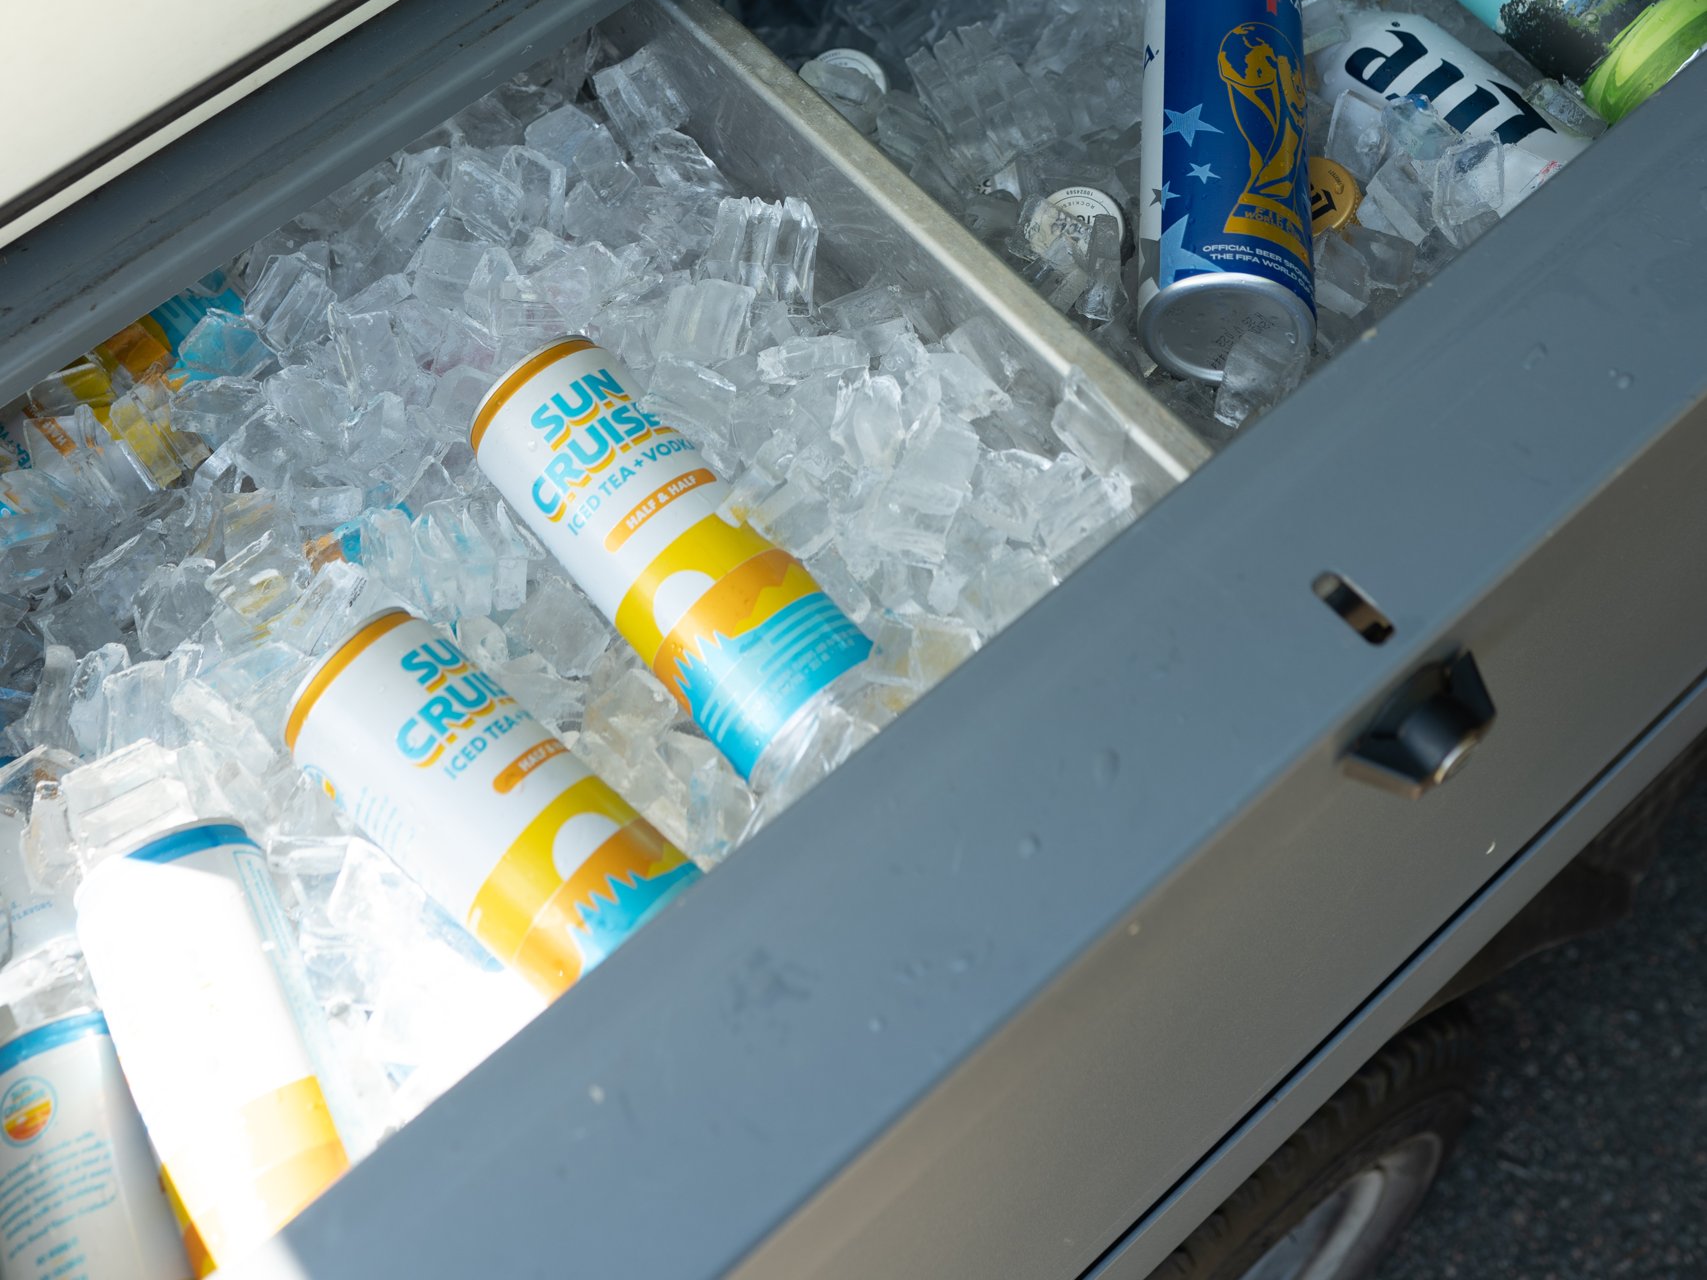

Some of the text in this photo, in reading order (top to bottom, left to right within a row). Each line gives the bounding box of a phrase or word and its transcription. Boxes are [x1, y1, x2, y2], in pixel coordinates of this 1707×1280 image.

[1202, 244, 1254, 254] OFFICIAL
[1255, 248, 1282, 263] BEER
[1209, 253, 1234, 261] THE
[1235, 253, 1260, 264] FIFA
[1261, 259, 1297, 281] WORLD
[531, 369, 628, 447] SUN
[567, 494, 601, 536] ICED
[625, 474, 697, 530] HALF & HALF
[401, 639, 470, 690] SU
[443, 736, 488, 780] ICED
